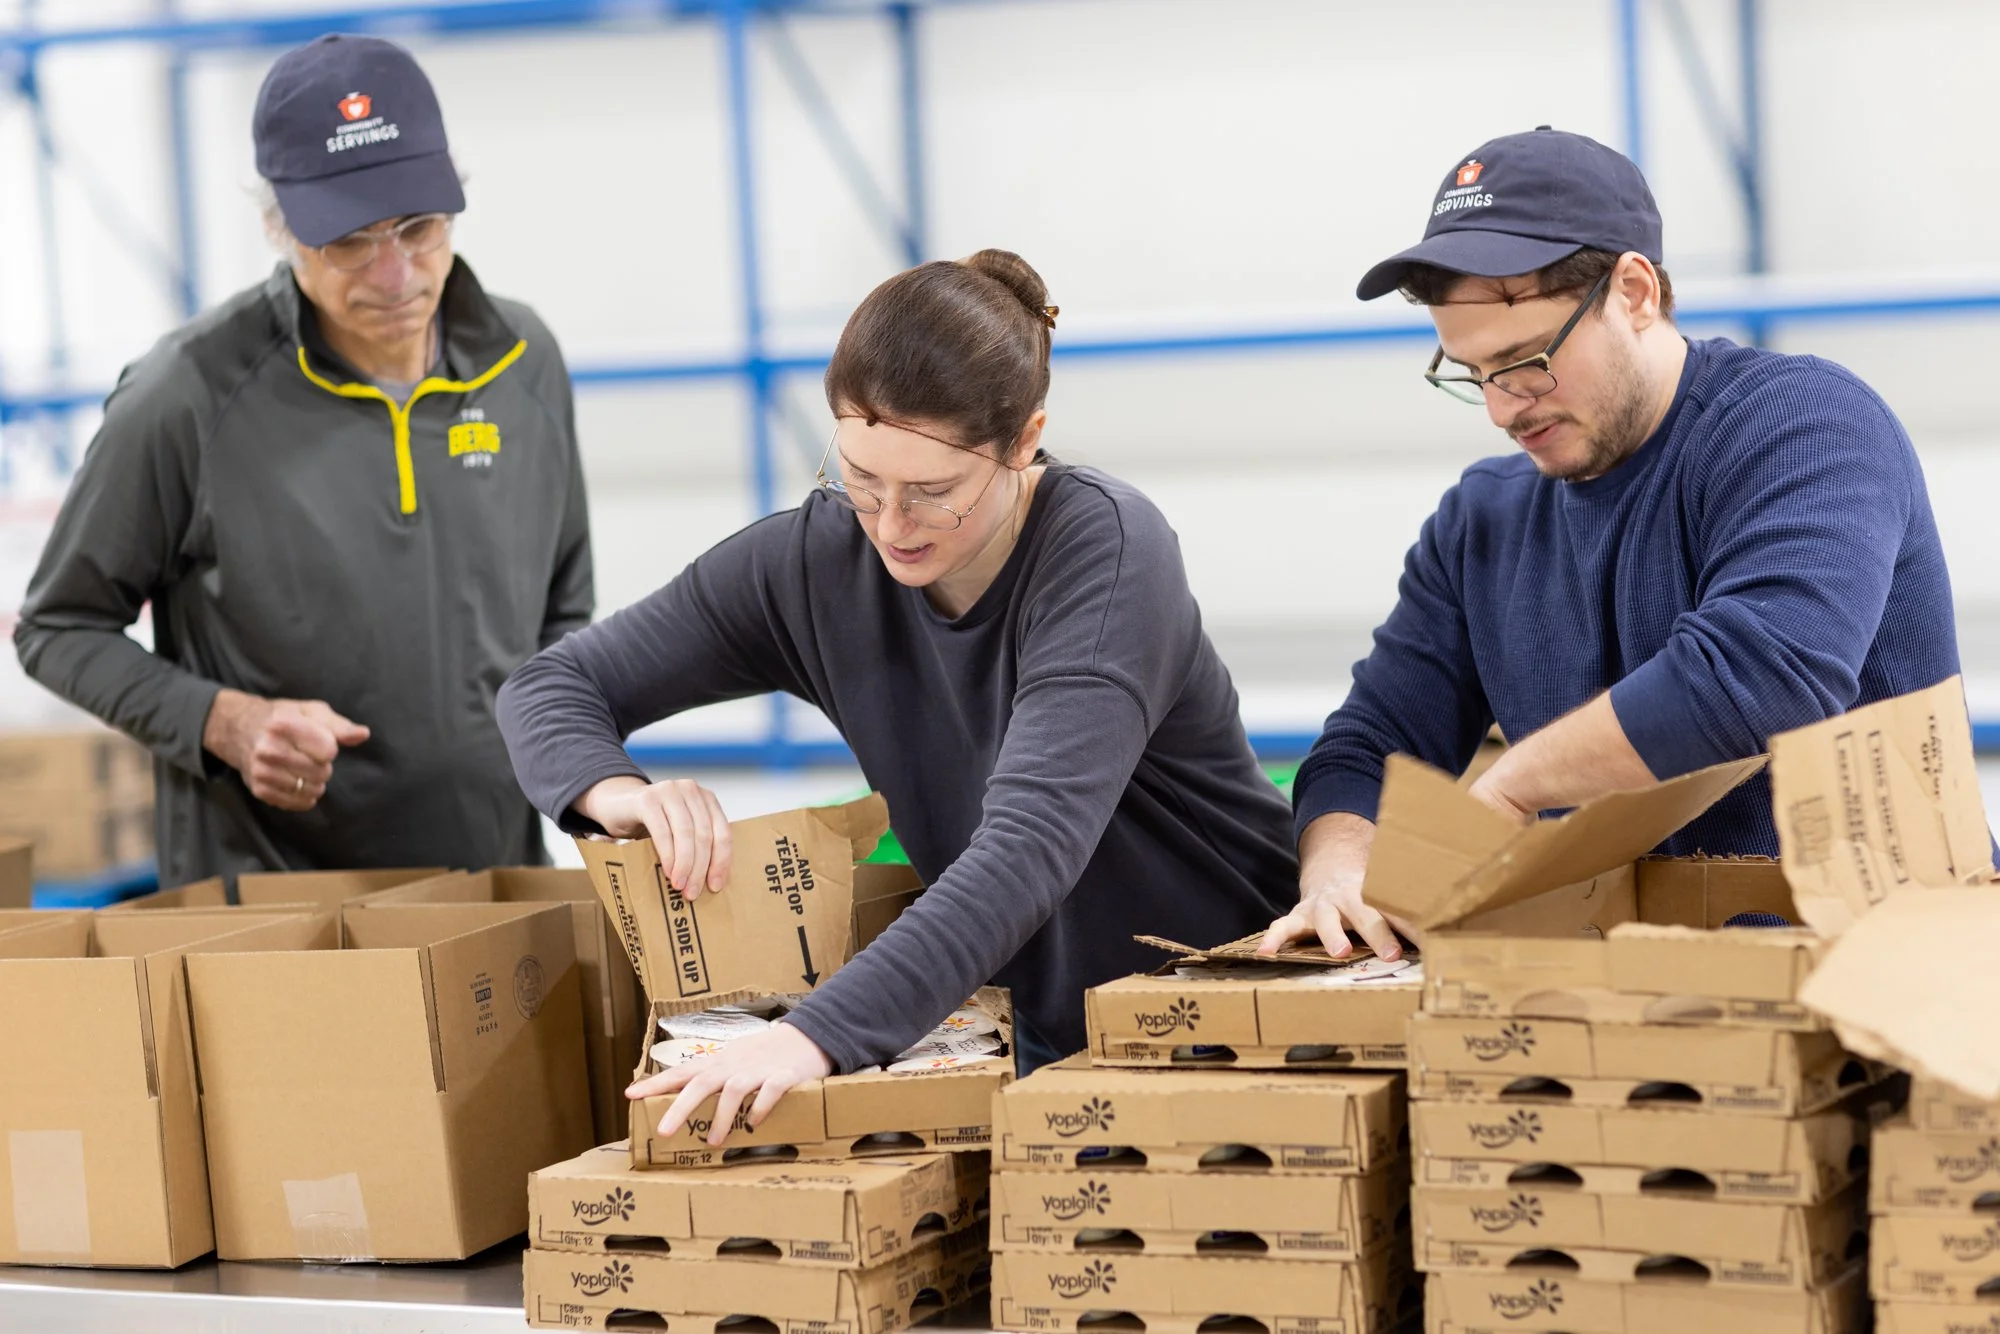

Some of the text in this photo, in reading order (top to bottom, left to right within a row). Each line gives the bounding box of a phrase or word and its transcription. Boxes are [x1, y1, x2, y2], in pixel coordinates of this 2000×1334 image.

[326, 123, 400, 154] SERVINGS
[1444, 185, 1483, 199] COMMUNITY
[1434, 193, 1494, 216] SERVINGS
[765, 864, 783, 894] OFF
[775, 836, 804, 915] TEAR TOP
[674, 916, 695, 957] SIDE
[683, 960, 700, 984] UP
[1135, 1011, 1188, 1031] Yoplait
[1045, 1111, 1100, 1130] Yoplait
[679, 1153, 712, 1167] Qty: 12
[571, 1199, 623, 1219] Yoplait
[1042, 1195, 1096, 1213] Yoplait
[583, 1235, 594, 1246] 12
[571, 1271, 621, 1289] Yoplait
[1048, 1273, 1102, 1291] Yoplait
[564, 1303, 584, 1314] Case
[564, 1314, 593, 1327] Qty: 12
